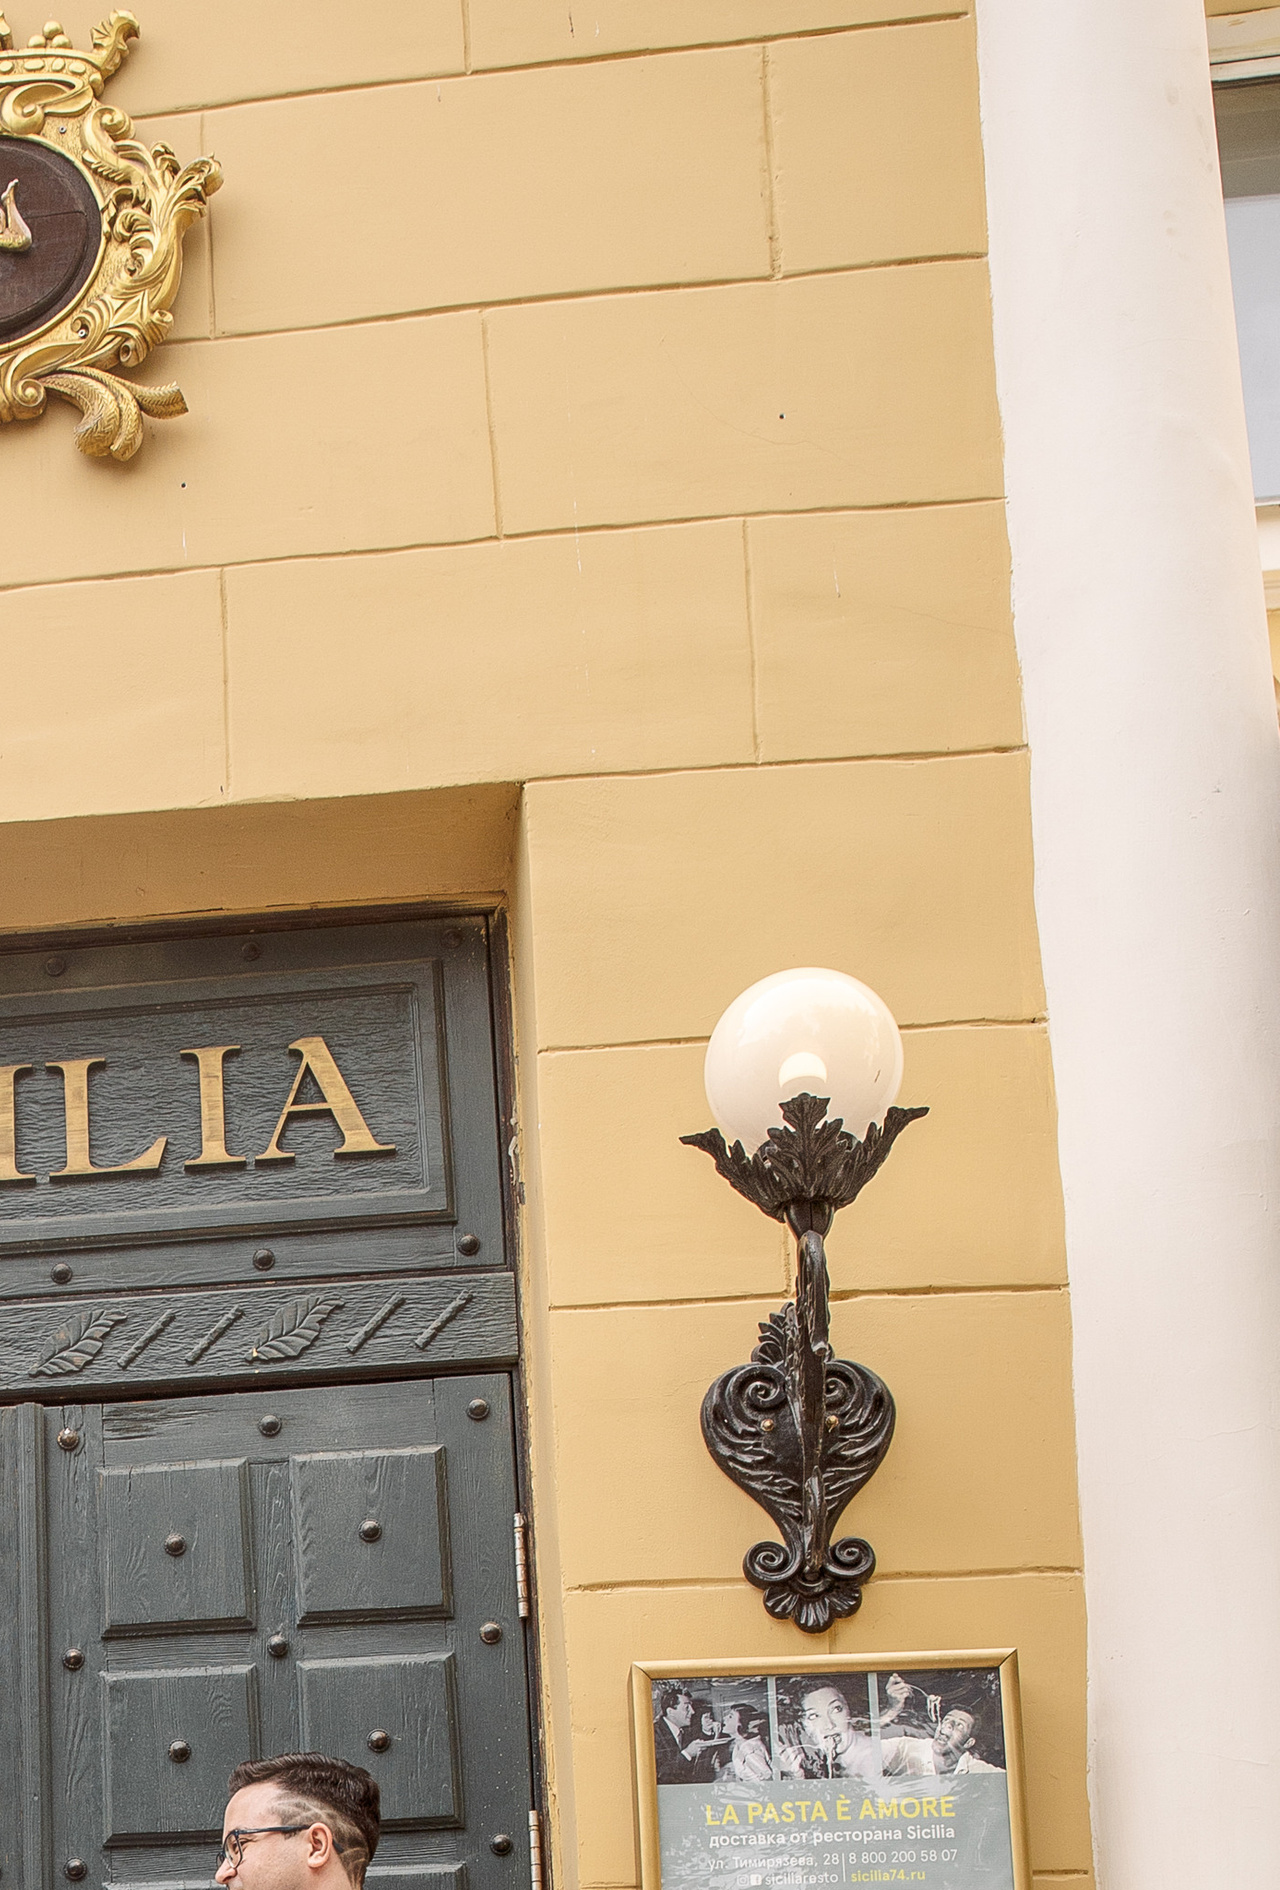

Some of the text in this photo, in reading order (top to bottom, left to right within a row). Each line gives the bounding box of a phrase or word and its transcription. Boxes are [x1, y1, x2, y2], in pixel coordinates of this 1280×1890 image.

[706, 1794, 956, 1825] LA PASTA È AMORE
[709, 1824, 955, 1848] доставка от ресторана Sicilia
[708, 1853, 839, 1872] ул. Тимирязева, 28
[848, 1849, 958, 1864] 8 800 200 58 07
[765, 1872, 839, 1885] siciliaresto
[851, 1869, 926, 1882] sicilia74.ru
